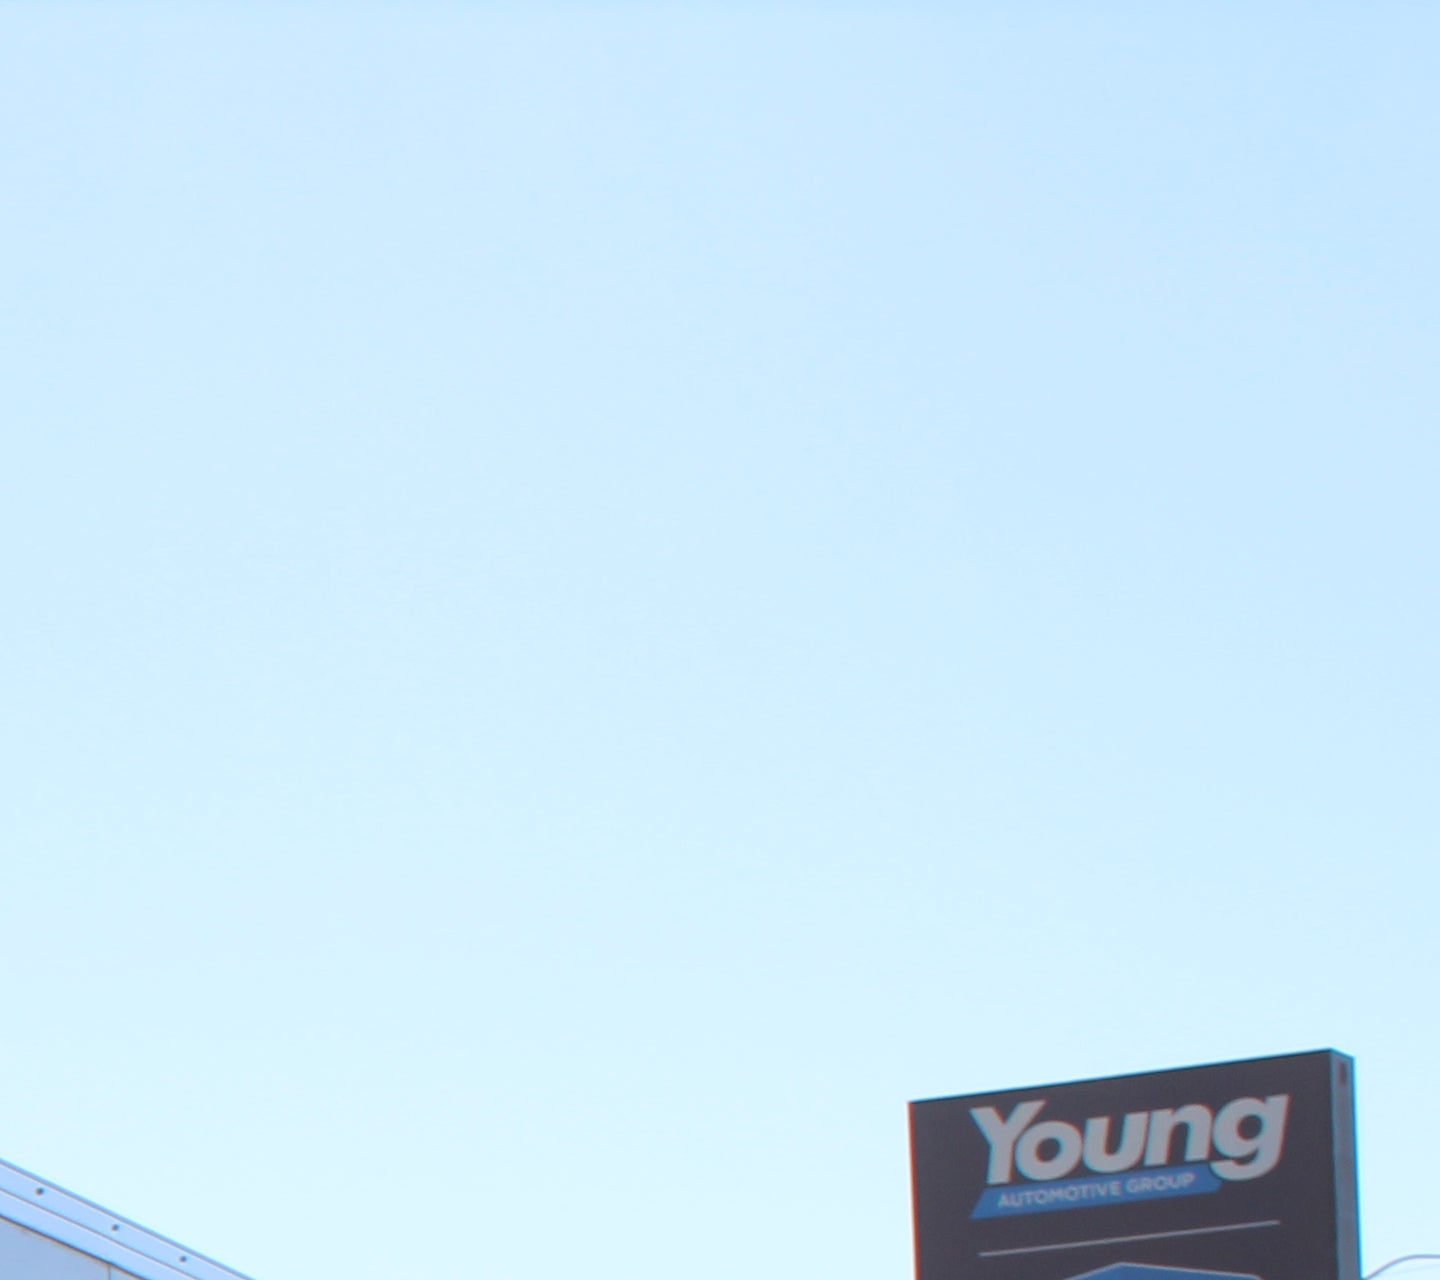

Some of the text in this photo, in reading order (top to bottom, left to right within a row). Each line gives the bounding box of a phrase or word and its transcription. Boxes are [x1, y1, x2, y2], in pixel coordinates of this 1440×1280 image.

[969, 1093, 1292, 1185] Young
[998, 1171, 1196, 1207] AUTOMOTIVE GROUP
